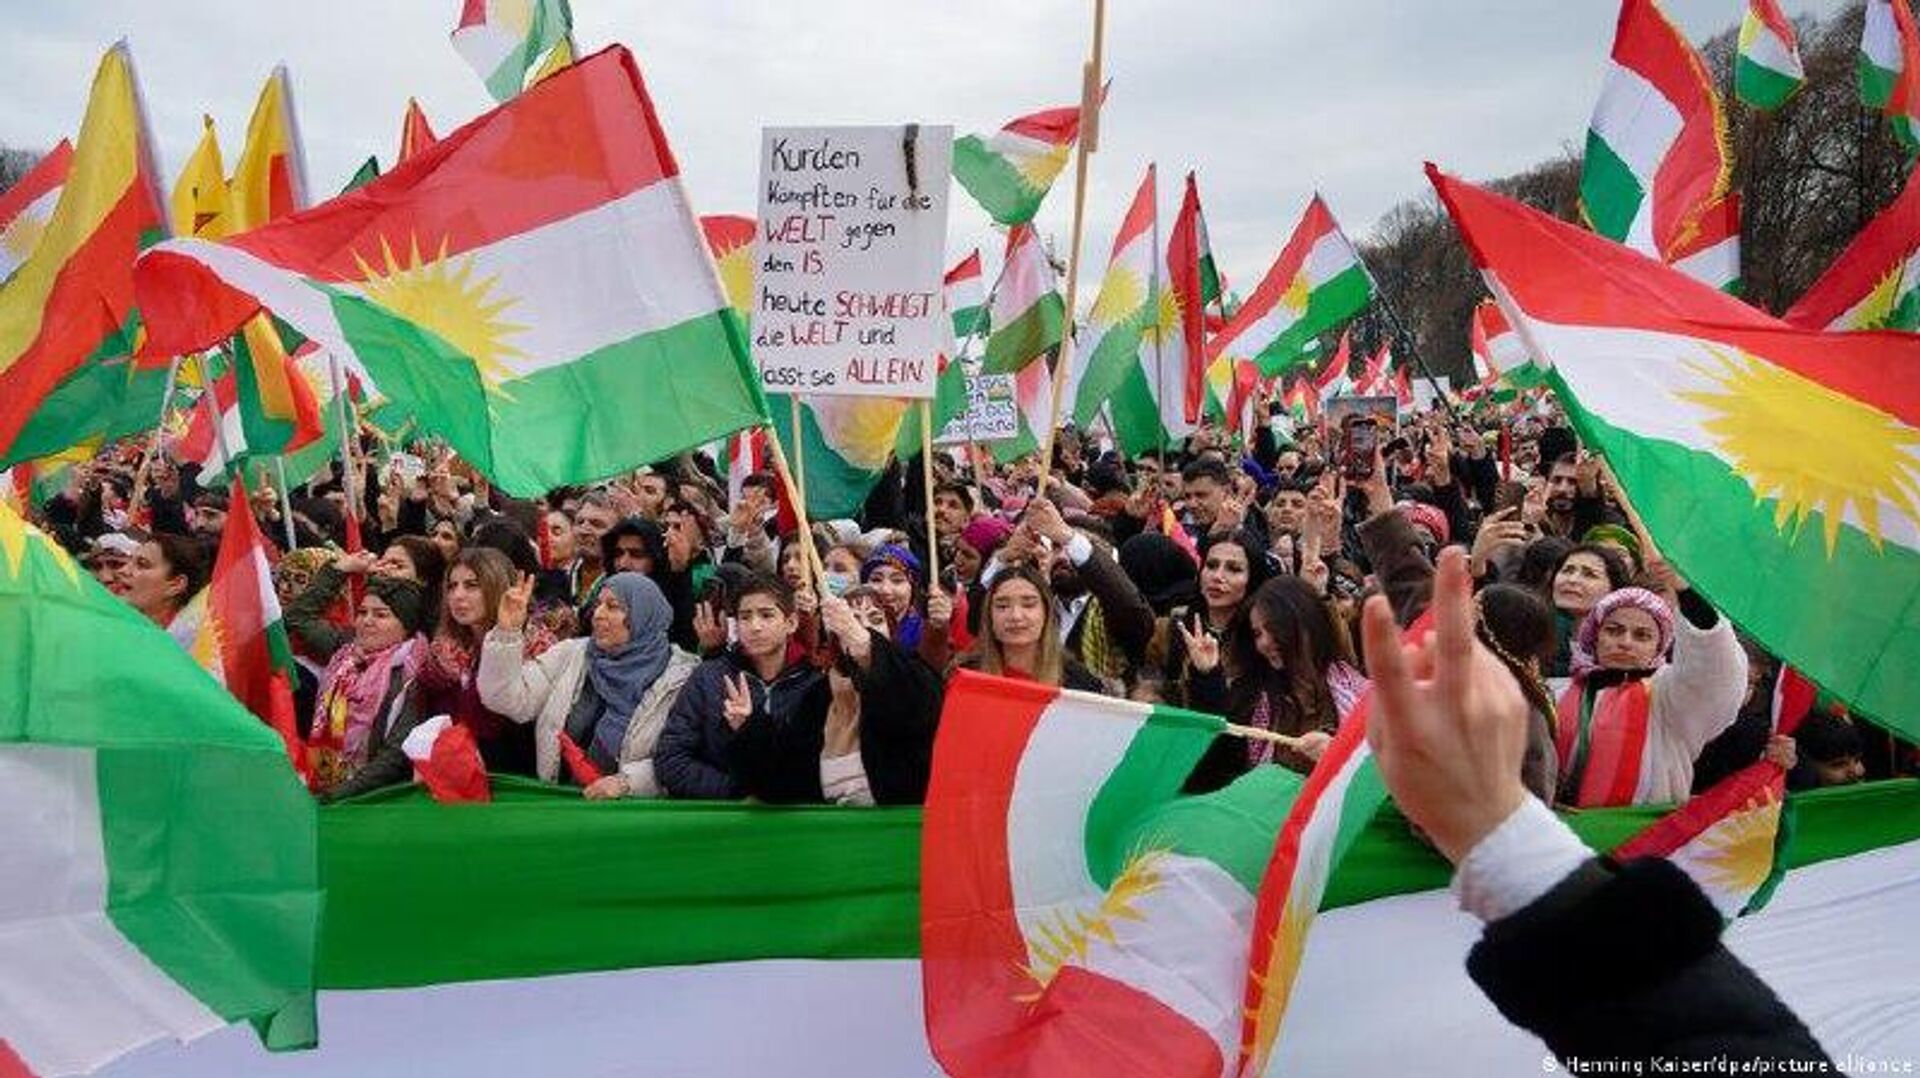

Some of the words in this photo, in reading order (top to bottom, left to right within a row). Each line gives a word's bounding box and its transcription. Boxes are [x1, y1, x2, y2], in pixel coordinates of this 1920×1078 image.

[771, 138, 860, 172] Kurden
[766, 214, 836, 244] WELT
[840, 221, 896, 251] gegen
[764, 253, 794, 272] den
[762, 286, 826, 316] heute
[790, 320, 850, 346] WELT
[859, 325, 896, 346] und
[810, 369, 836, 387] sie
